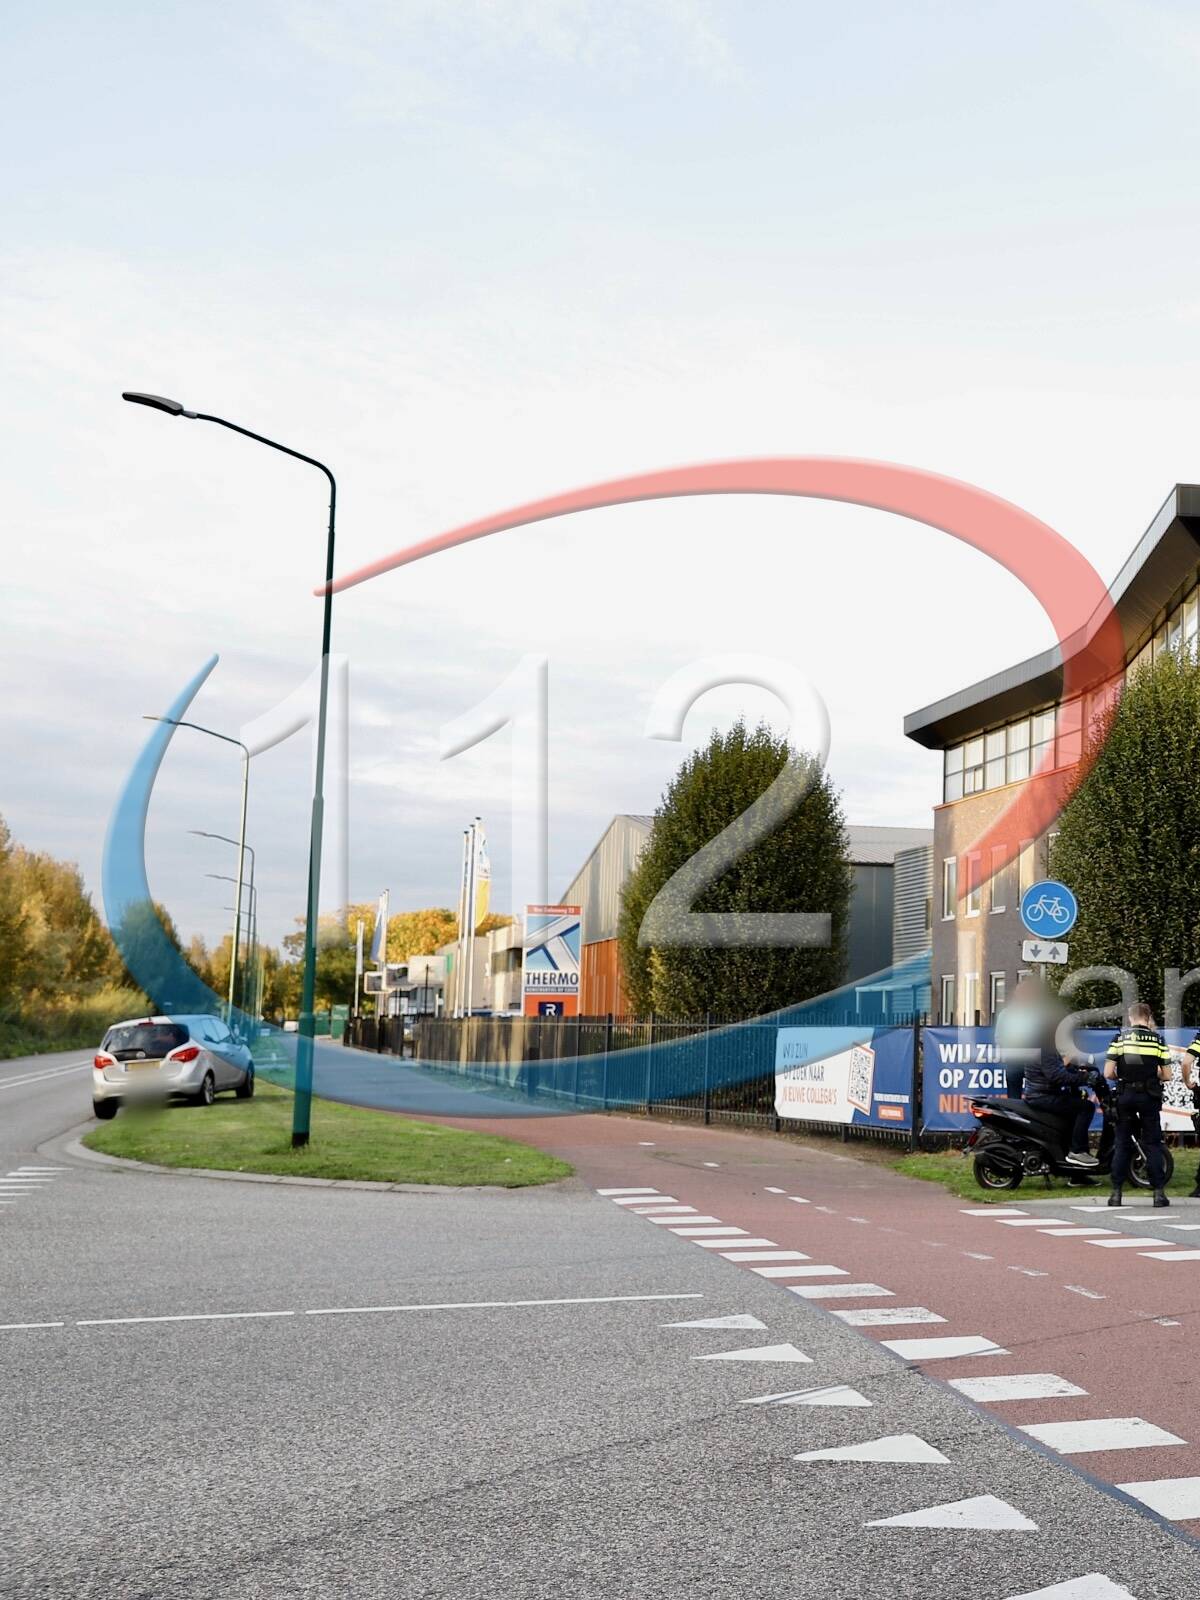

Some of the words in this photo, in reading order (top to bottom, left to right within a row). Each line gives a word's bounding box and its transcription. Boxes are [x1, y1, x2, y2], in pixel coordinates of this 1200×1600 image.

[526, 972, 579, 985] THERMO
[938, 1043, 971, 1064] WIJ
[975, 1043, 1007, 1064] ZIJ
[808, 1065, 825, 1082] NAAR
[938, 1068, 964, 1089] OP
